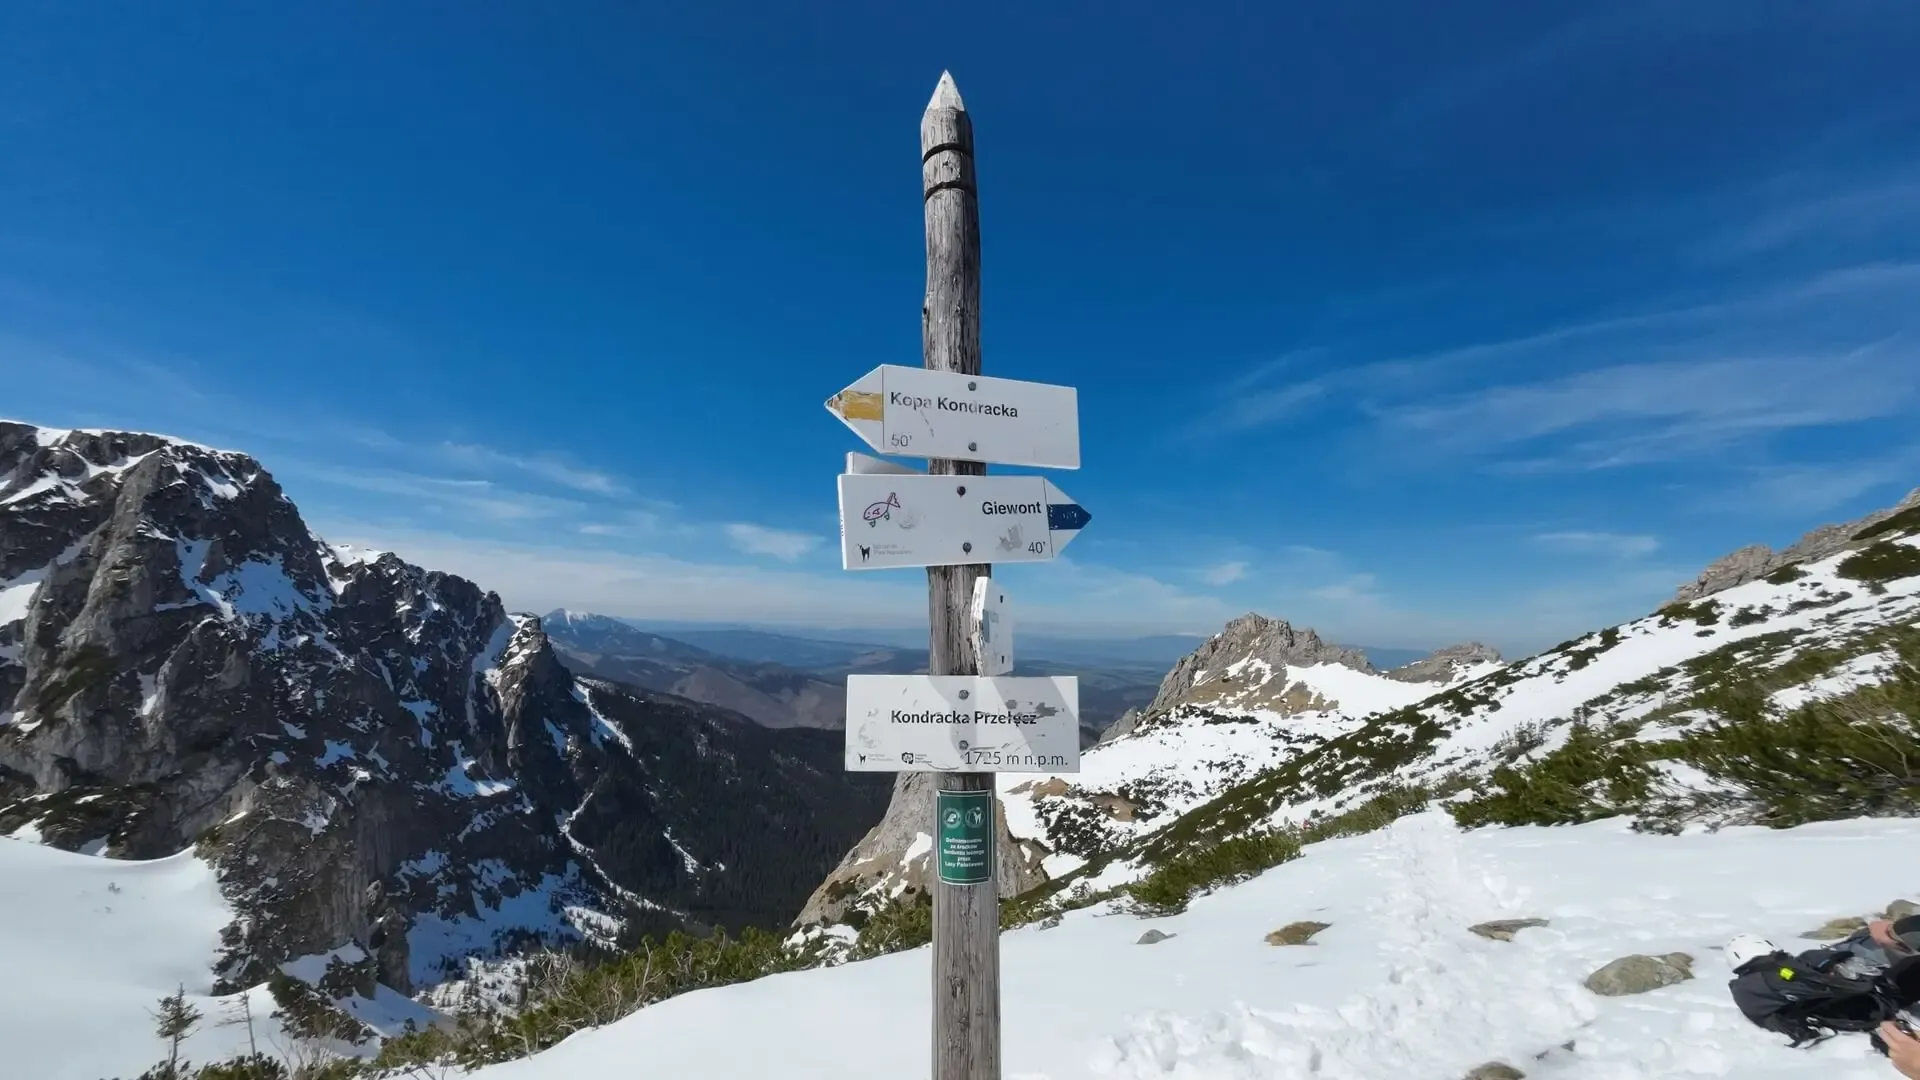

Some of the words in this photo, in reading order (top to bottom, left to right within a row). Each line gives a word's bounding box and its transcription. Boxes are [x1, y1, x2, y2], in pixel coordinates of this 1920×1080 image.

[890, 391, 932, 411] Kopa
[937, 396, 1018, 418] Kondracka
[890, 432, 912, 447] 50'
[982, 501, 1042, 515] Giewont
[1028, 541, 1046, 554] 40'
[891, 710, 970, 724] Kondracka
[974, 710, 1037, 728] Przełęcz
[964, 751, 1001, 765] 1725
[1006, 754, 1019, 765] m
[1024, 755, 1068, 768] n.p.m.
